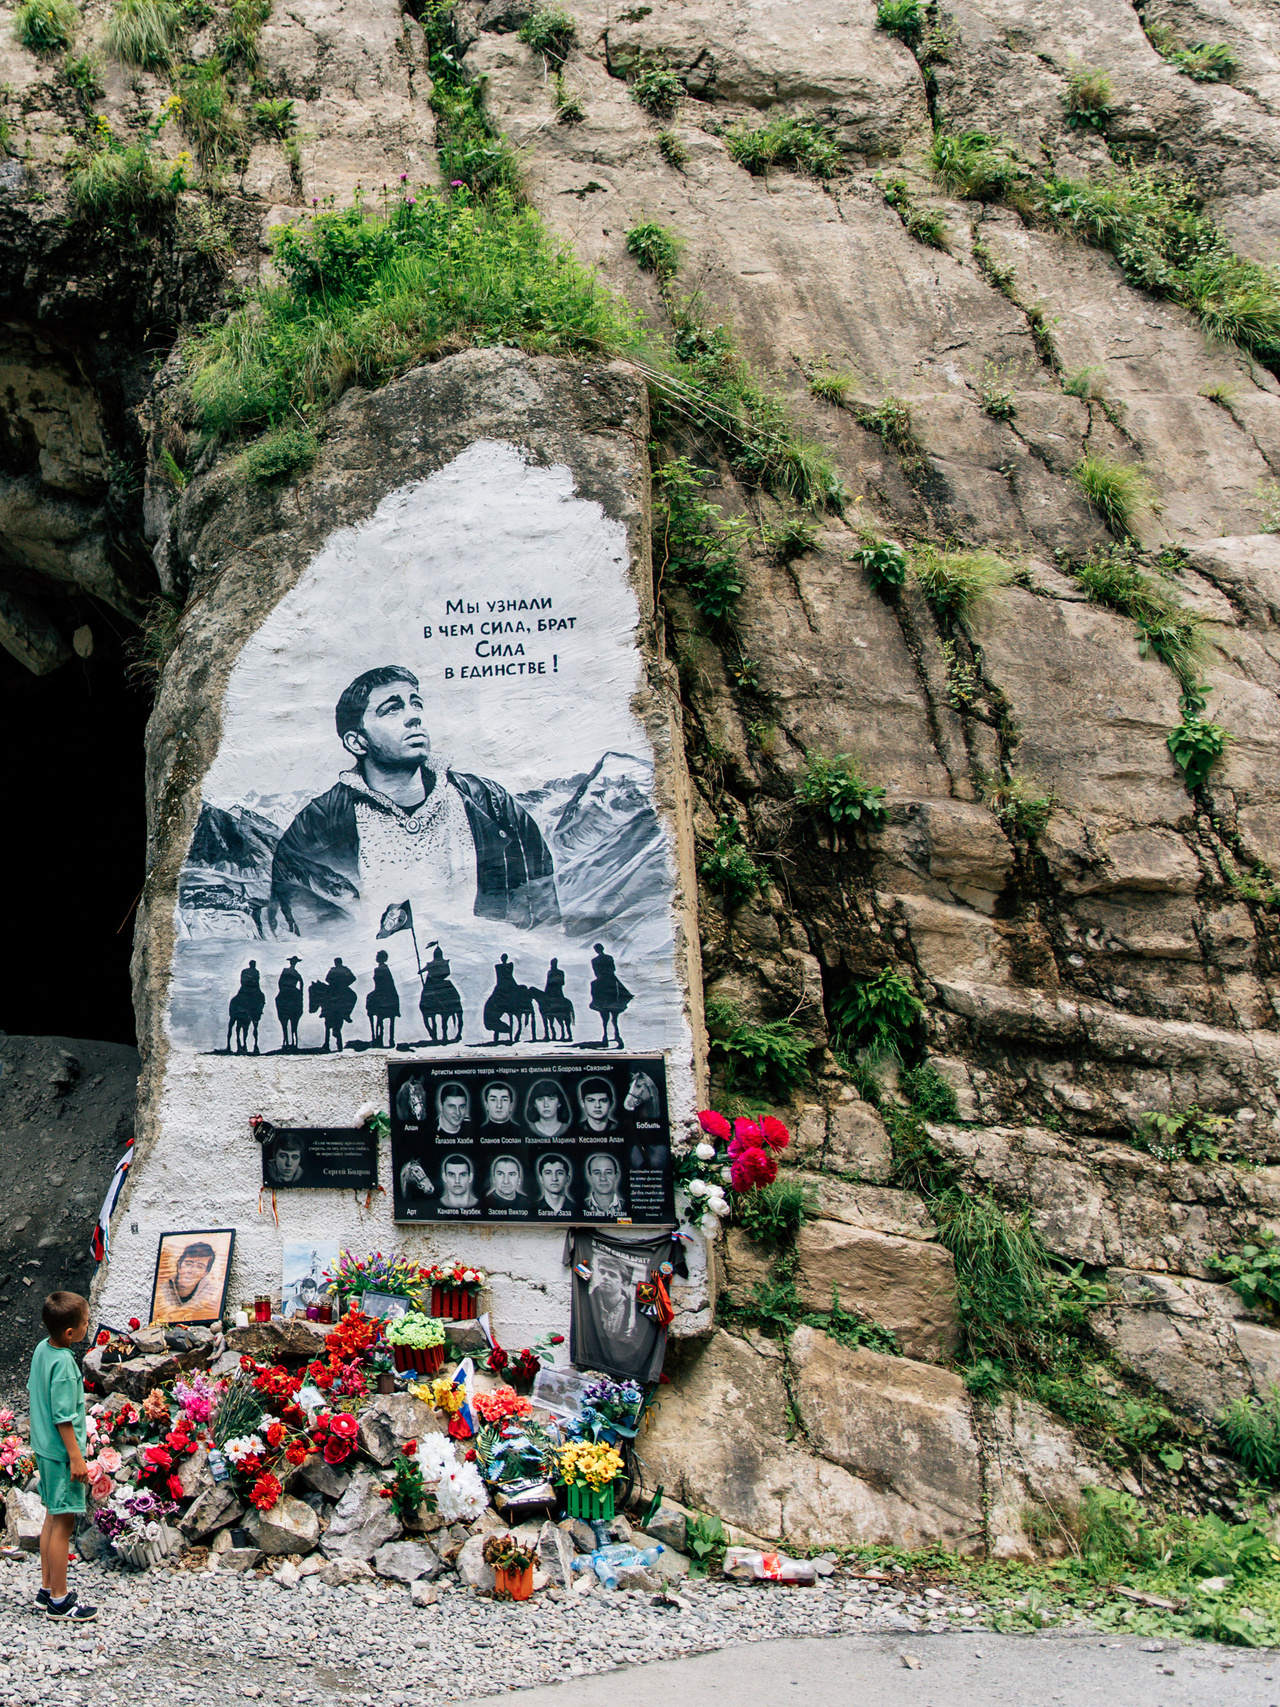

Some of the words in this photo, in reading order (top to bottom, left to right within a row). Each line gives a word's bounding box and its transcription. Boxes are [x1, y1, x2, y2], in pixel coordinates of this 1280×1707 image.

[423, 626, 432, 639] В
[439, 623, 474, 637] ЧЕМ
[480, 621, 531, 636] СИЛА,
[537, 617, 577, 632] БРАТ
[445, 667, 455, 680] В
[636, 1122, 661, 1130] Бобыль
[406, 1208, 417, 1216] Арт
